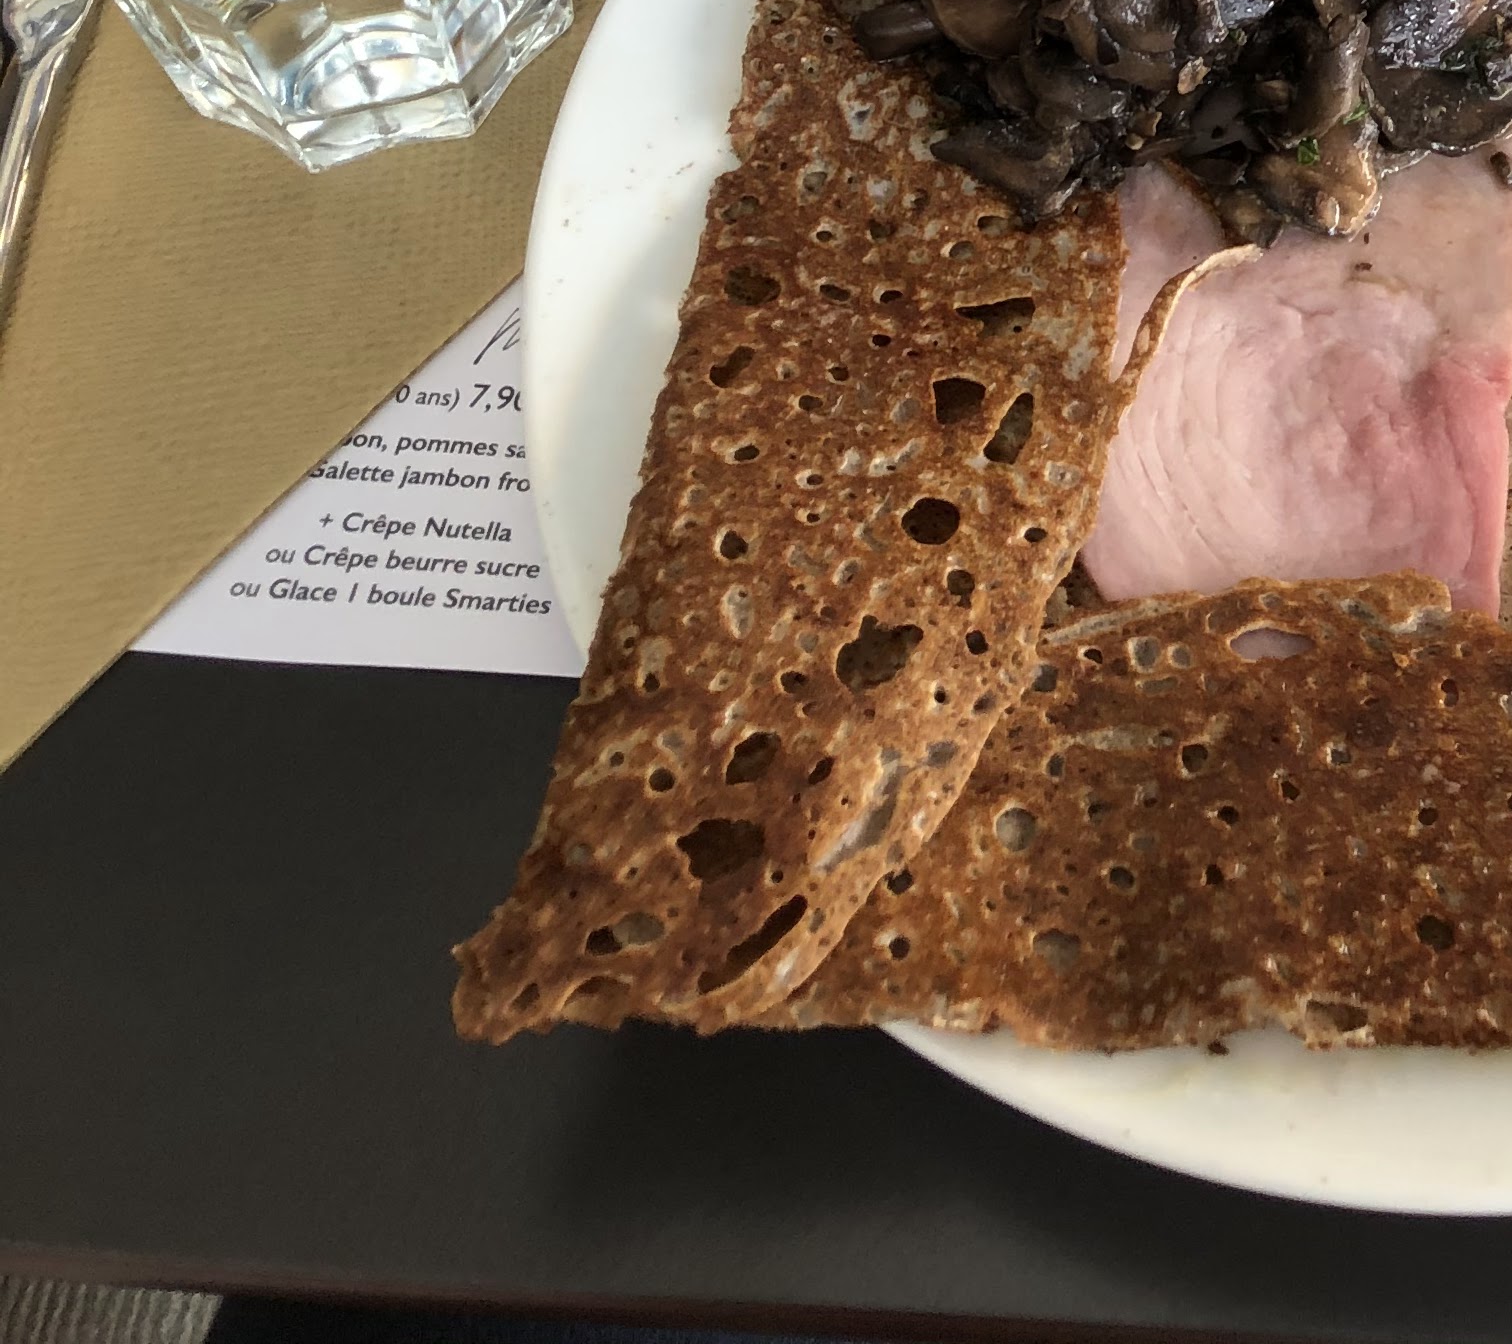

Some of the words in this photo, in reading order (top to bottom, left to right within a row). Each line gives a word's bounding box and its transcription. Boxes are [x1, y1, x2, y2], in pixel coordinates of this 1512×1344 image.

[342, 511, 416, 542] Crêpe
[423, 516, 512, 543] Nutella
[265, 547, 296, 565] ou
[304, 544, 379, 576] Crêpe
[385, 549, 467, 574] beurre
[474, 560, 541, 580] sucre
[229, 581, 261, 599] ou
[269, 577, 338, 603] Glace
[367, 583, 436, 608] boule
[442, 587, 552, 616] Smarties
